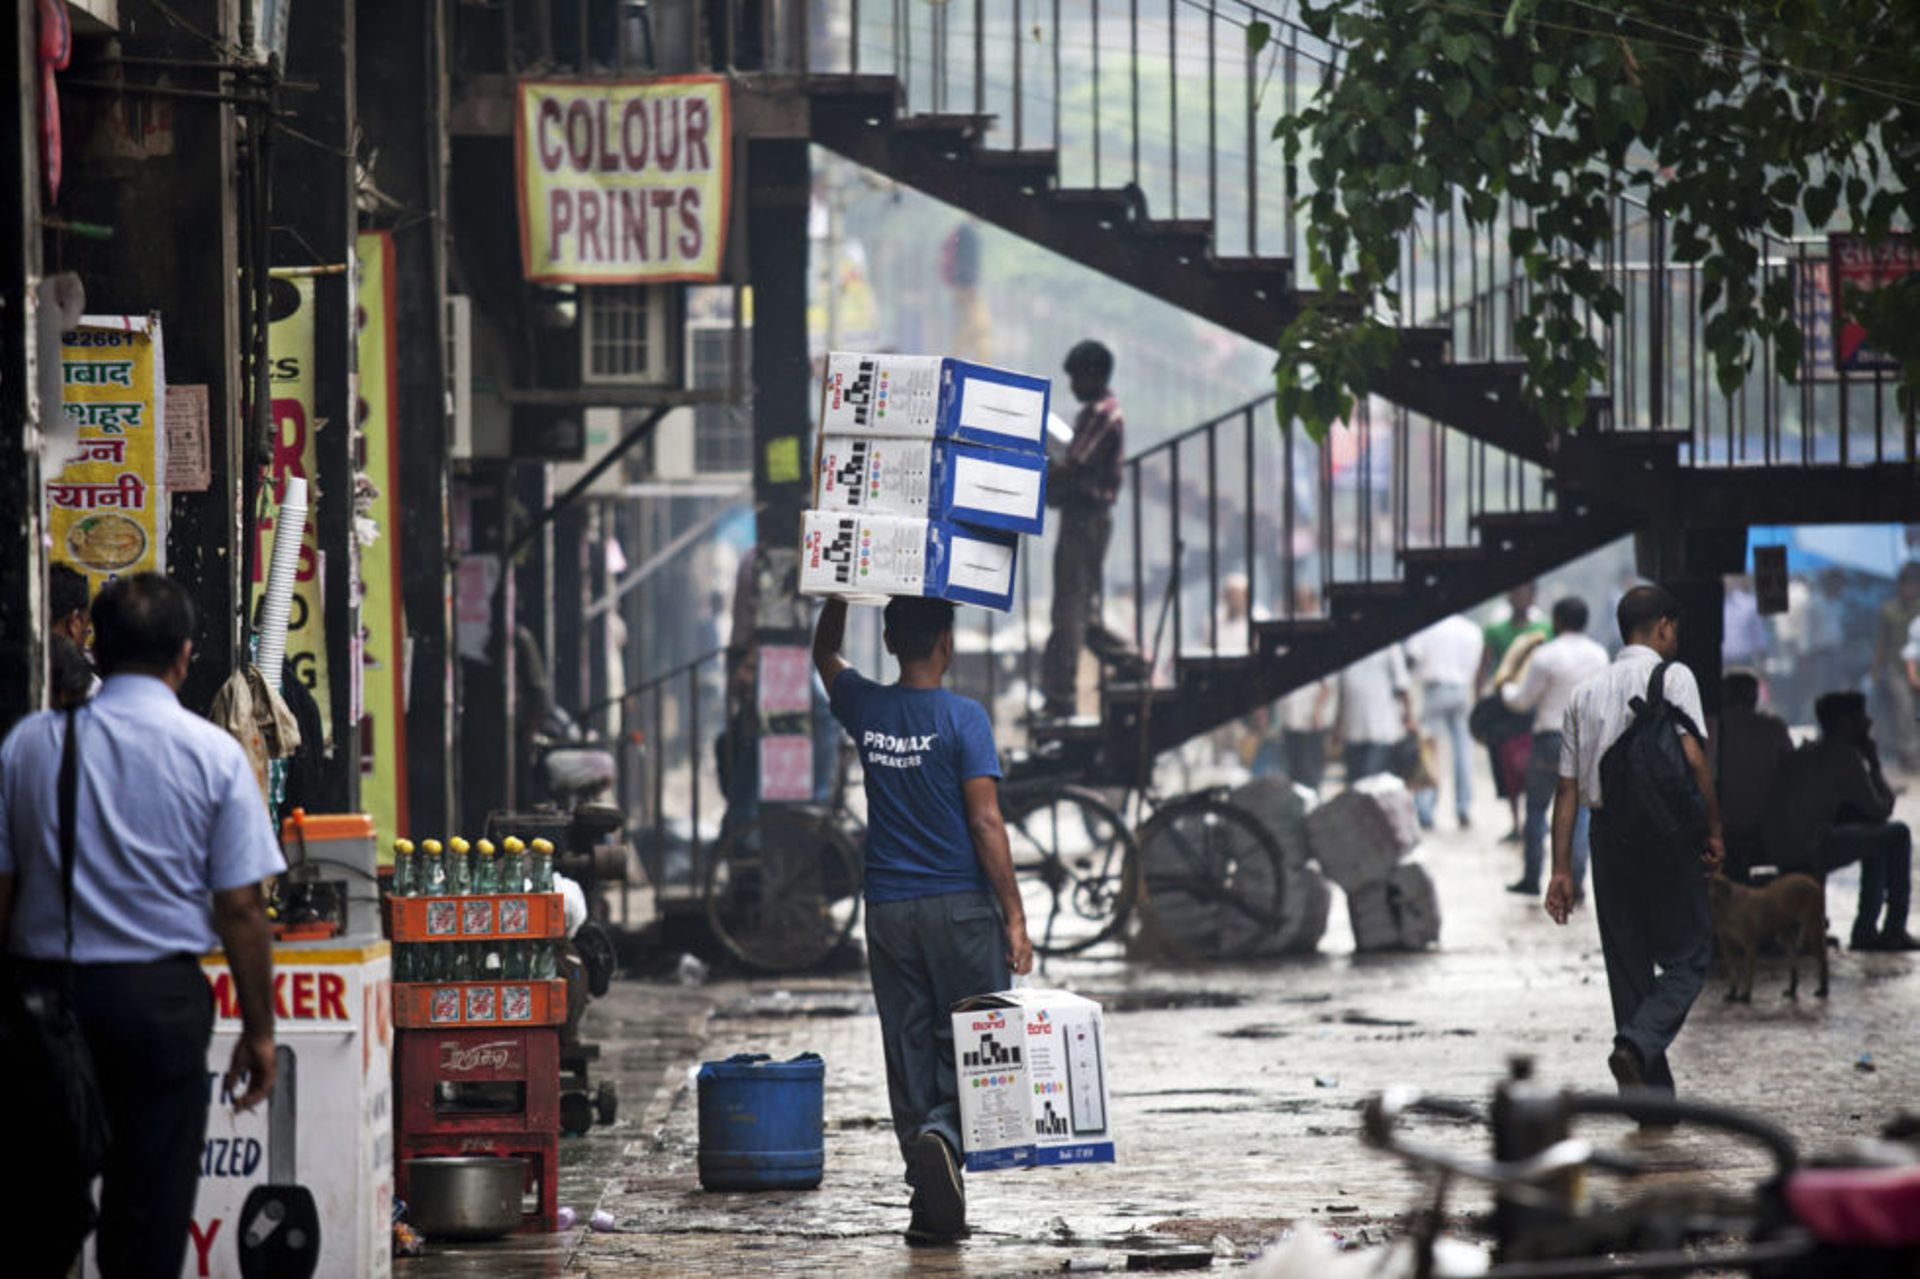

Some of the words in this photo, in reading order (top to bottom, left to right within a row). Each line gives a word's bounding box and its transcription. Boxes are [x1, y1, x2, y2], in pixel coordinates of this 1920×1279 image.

[538, 97, 710, 172] COLOUR
[549, 187, 702, 261] PRINTS
[63, 362, 131, 385] ाबाद
[64, 403, 142, 433] शहूर
[862, 729, 937, 753] PROMAX
[867, 752, 922, 769] SPEAKERS
[201, 1137, 262, 1178] IZED
